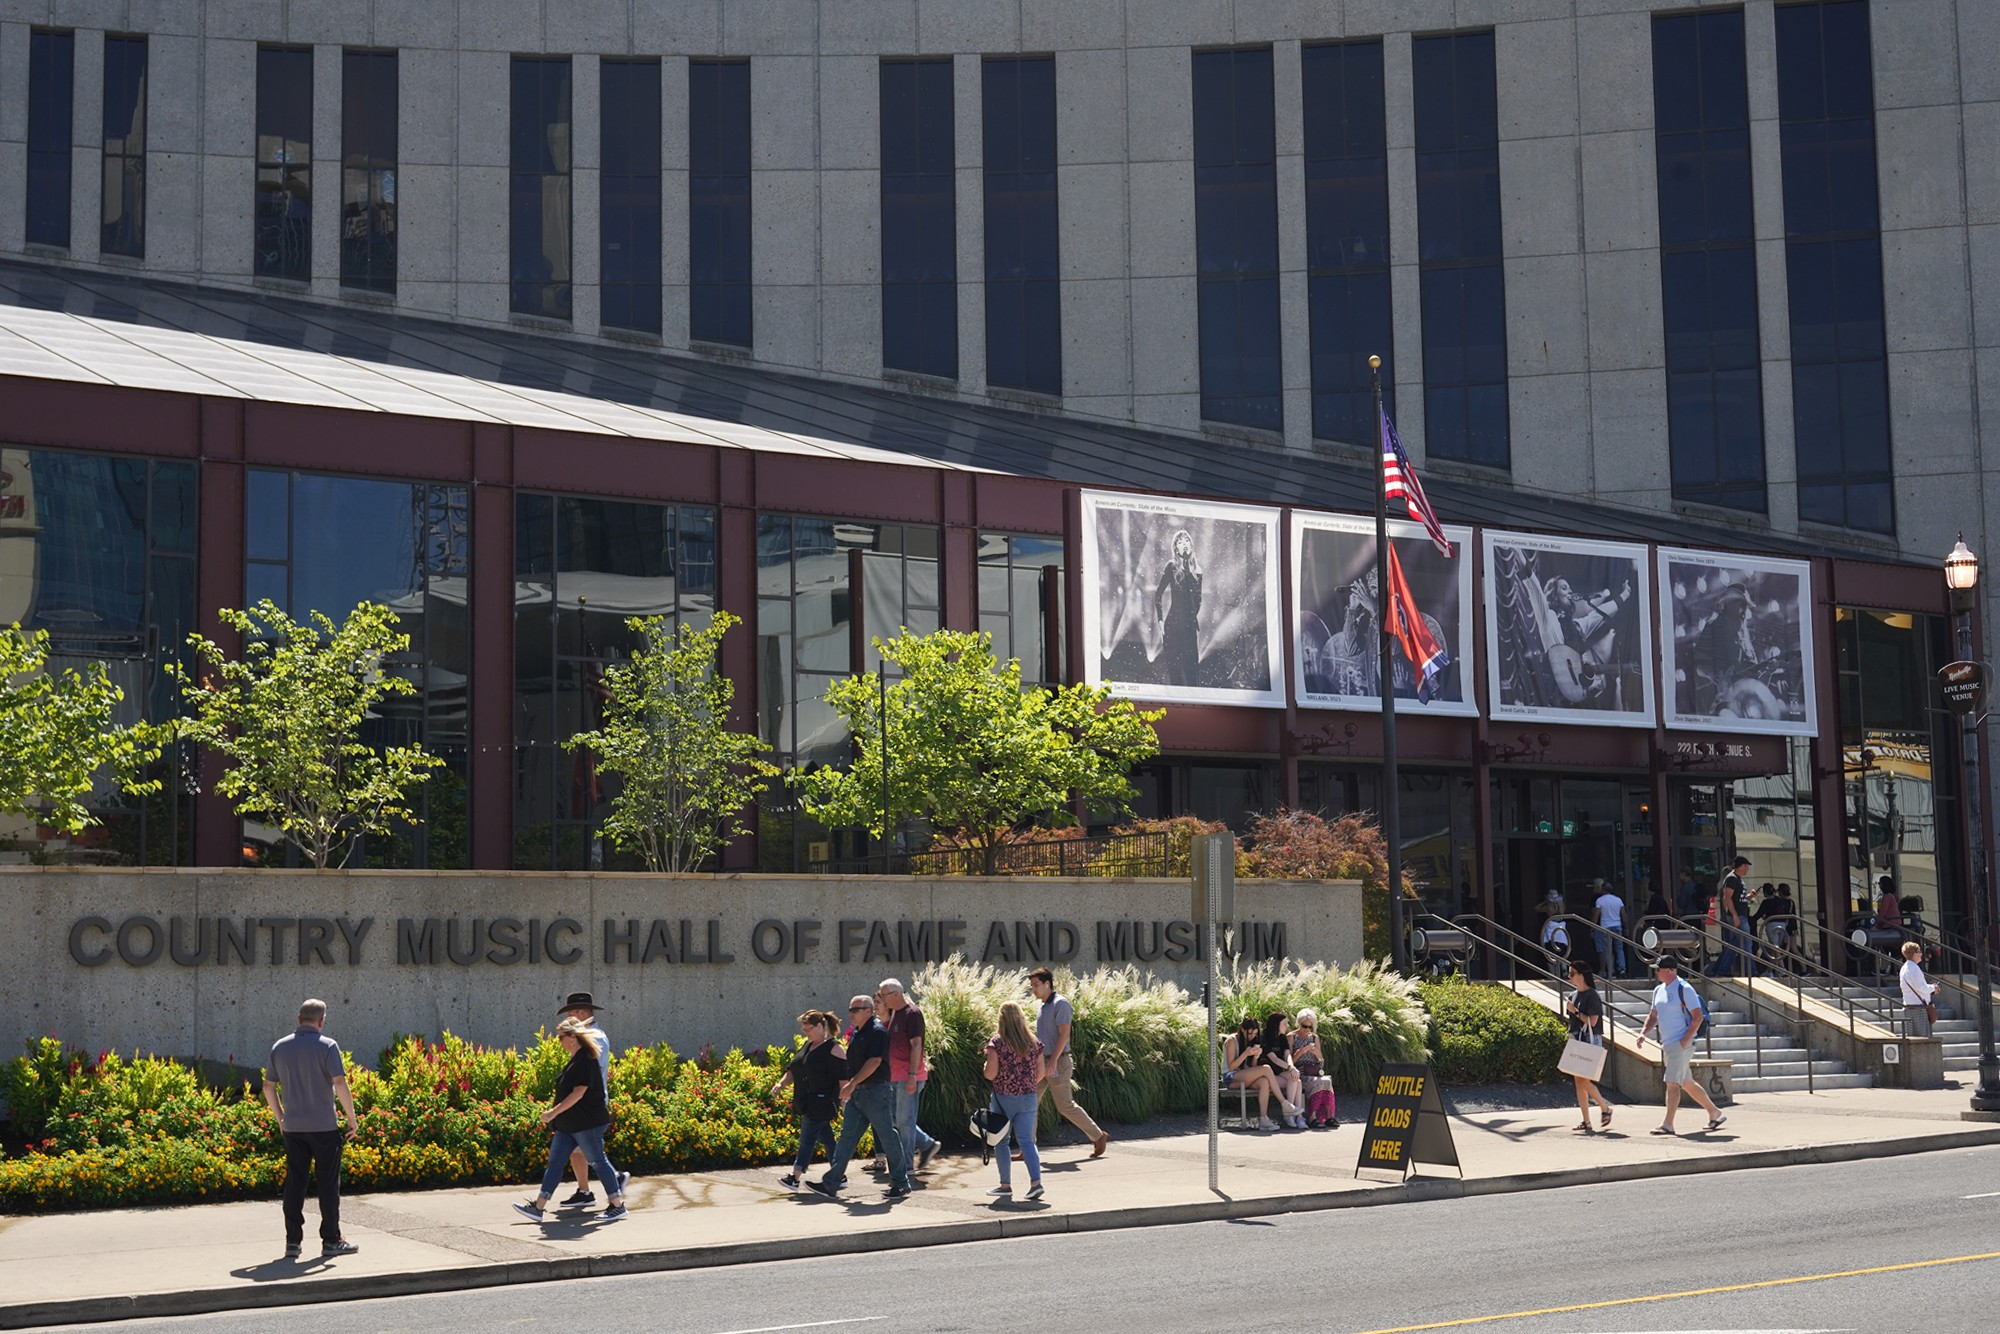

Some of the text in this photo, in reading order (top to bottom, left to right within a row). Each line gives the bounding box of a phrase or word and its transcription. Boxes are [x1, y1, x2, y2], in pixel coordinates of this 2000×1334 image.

[1943, 682, 1980, 693] LIVE MUSIC
[1952, 692, 1973, 701] VENUE
[1745, 745, 1752, 757] S.
[69, 915, 374, 967] COUNTRY
[397, 916, 584, 966] MUSIC
[603, 919, 735, 964] HALL
[752, 918, 822, 964] OF
[838, 920, 968, 963] FAME
[982, 921, 1081, 963] AND
[1376, 1075, 1424, 1097] SHUTTLE
[1373, 1107, 1412, 1129] LOADS
[1370, 1139, 1402, 1161] HERE
